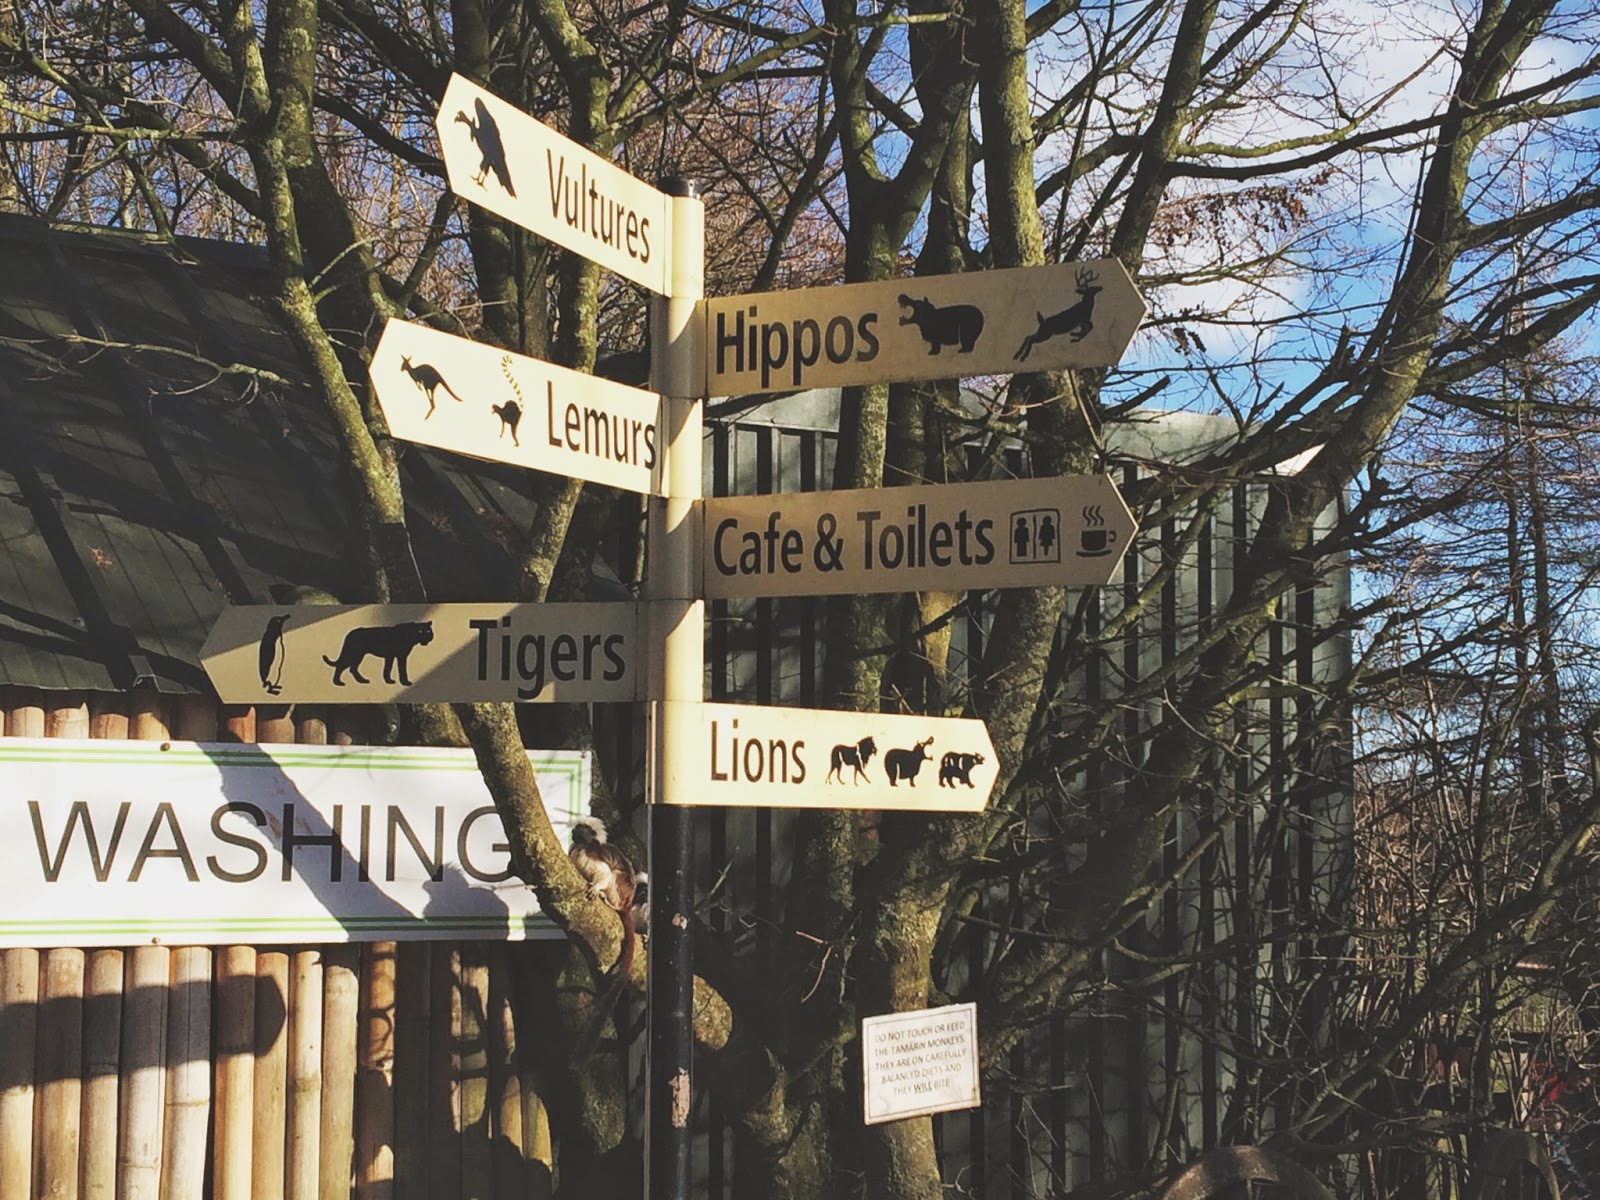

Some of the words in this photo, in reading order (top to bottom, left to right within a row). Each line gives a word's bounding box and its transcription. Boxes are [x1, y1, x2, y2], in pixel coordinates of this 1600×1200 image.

[546, 148, 650, 264] Vultures
[716, 305, 880, 388] Hippos
[547, 381, 656, 470] Lemurs
[713, 512, 804, 576] Cafe
[813, 513, 844, 573] &
[856, 504, 995, 571] Toilets
[469, 618, 626, 699] Tigers
[710, 718, 807, 785] Lions
[27, 800, 513, 883] WASHING
[874, 1048, 888, 1056] THE
[892, 1042, 926, 1054] TAMARIN
[888, 1031, 905, 1040] NOT
[908, 1026, 932, 1038] TOUCH
[935, 1024, 944, 1033] OR
[947, 1021, 965, 1031] FEED
[896, 1058, 910, 1067] ARE
[912, 1056, 924, 1065] ON
[925, 1049, 966, 1062] CAREFULLY
[945, 1063, 962, 1072] AND
